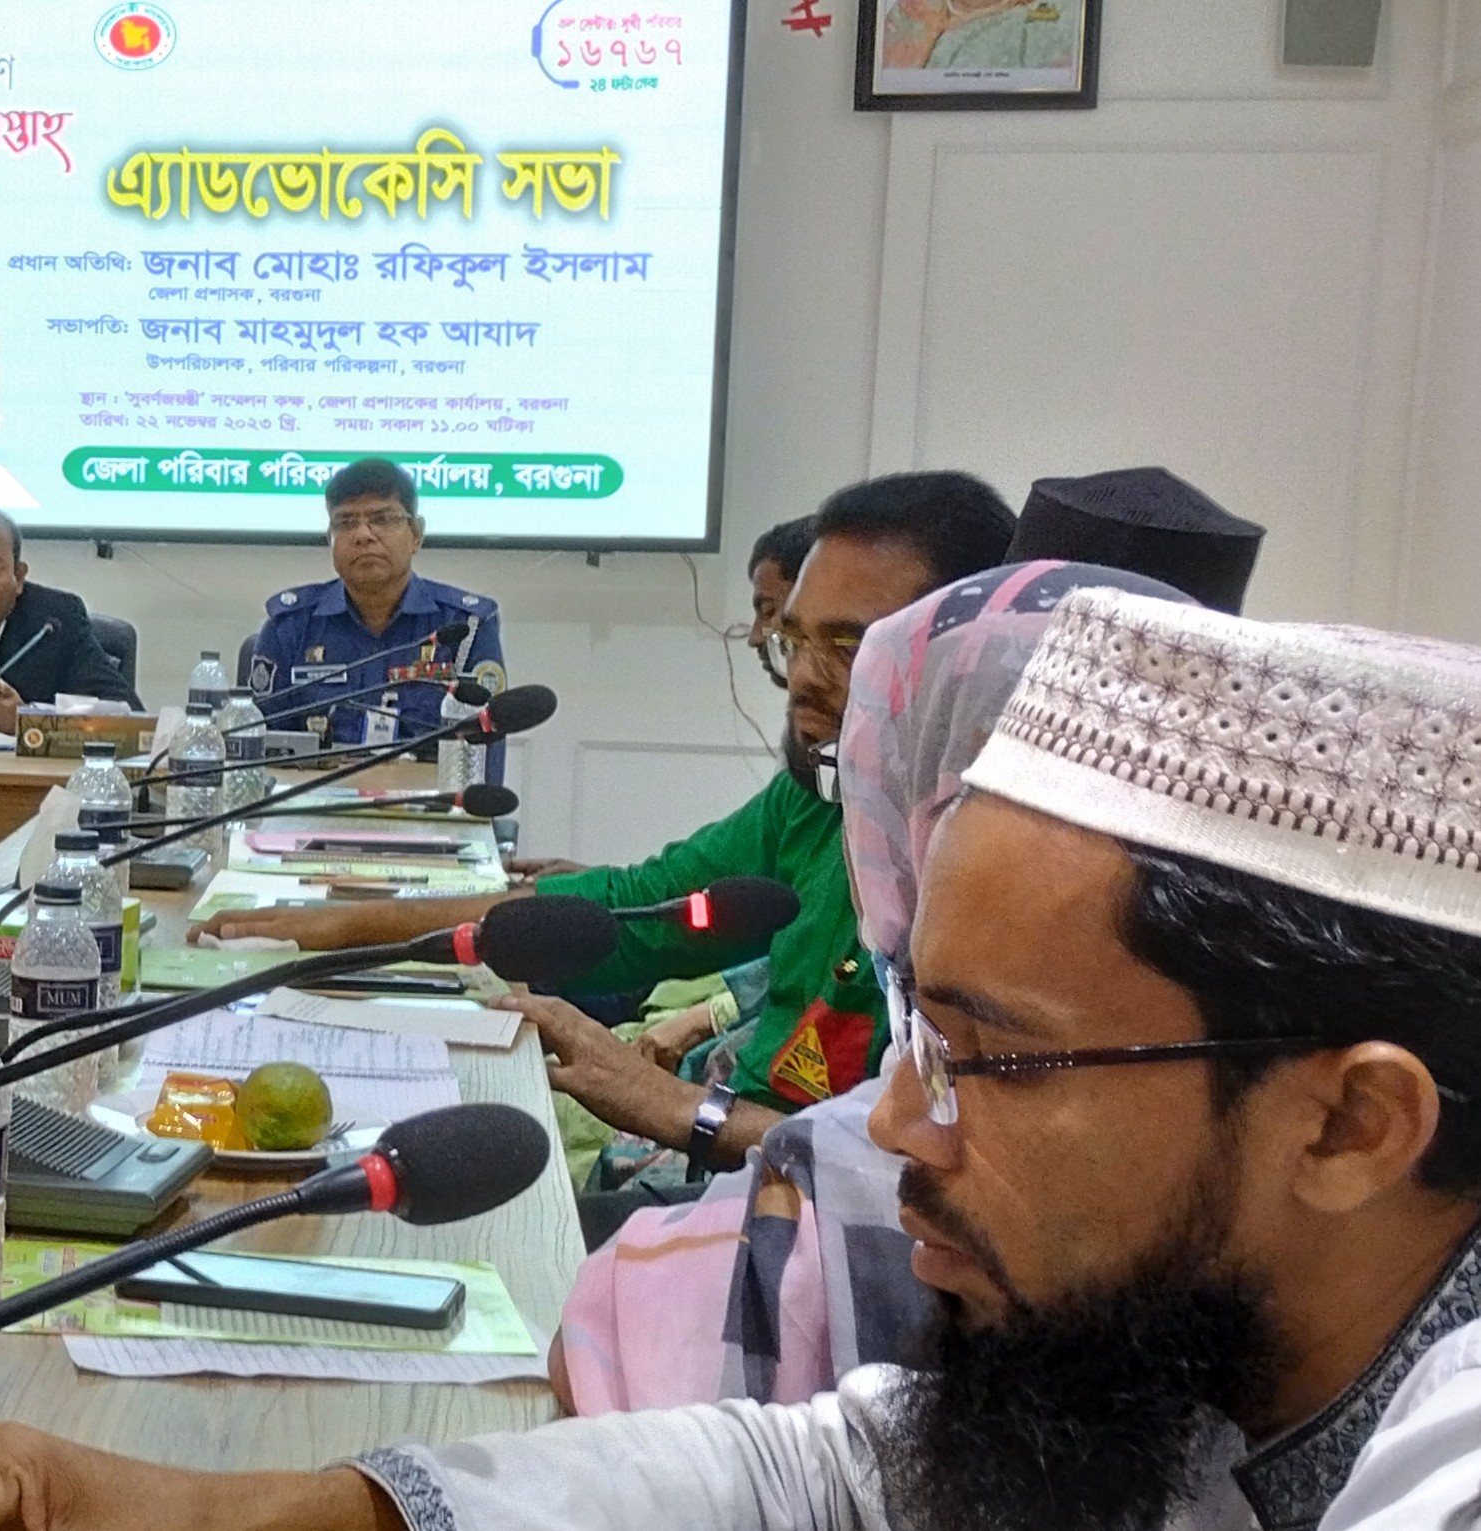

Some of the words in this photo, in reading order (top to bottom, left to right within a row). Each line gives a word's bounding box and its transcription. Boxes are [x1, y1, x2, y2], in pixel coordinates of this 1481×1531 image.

[557, 39, 682, 67] ১৬৭৬৭
[589, 77, 607, 92] ২৪
[107, 127, 484, 221] এ্যাডভোকেসি
[494, 144, 623, 221] সভা
[7, 253, 59, 272] প্রধান
[140, 248, 242, 282] জনাব
[371, 241, 512, 293] রফিকুল
[521, 242, 654, 283] ইসলাম
[148, 286, 190, 302] জেলা
[268, 287, 322, 303] বরগুনা
[138, 316, 226, 346] জনাব
[233, 317, 366, 352] মাহমুদুল
[374, 320, 432, 348] হক
[439, 318, 542, 348] আযাদ
[259, 353, 318, 373] পরিবার
[412, 359, 467, 375] বরগুনা
[210, 393, 267, 409] সম্মেলন
[318, 394, 359, 410] জেলা
[361, 395, 439, 411] প্রশাসকের
[518, 396, 570, 412] বরগুনা
[136, 415, 160, 429] ২২
[164, 414, 219, 429] নভেম্বর
[223, 415, 272, 431] ২০২৩
[379, 417, 425, 433] সকাল
[430, 419, 479, 434] ১১.০০
[486, 415, 536, 434] ঘটিকা
[81, 454, 150, 484] জেলা
[157, 449, 252, 487] পরিবার
[512, 461, 604, 493] বরগুনা
[45, 990, 82, 1007] MUM
